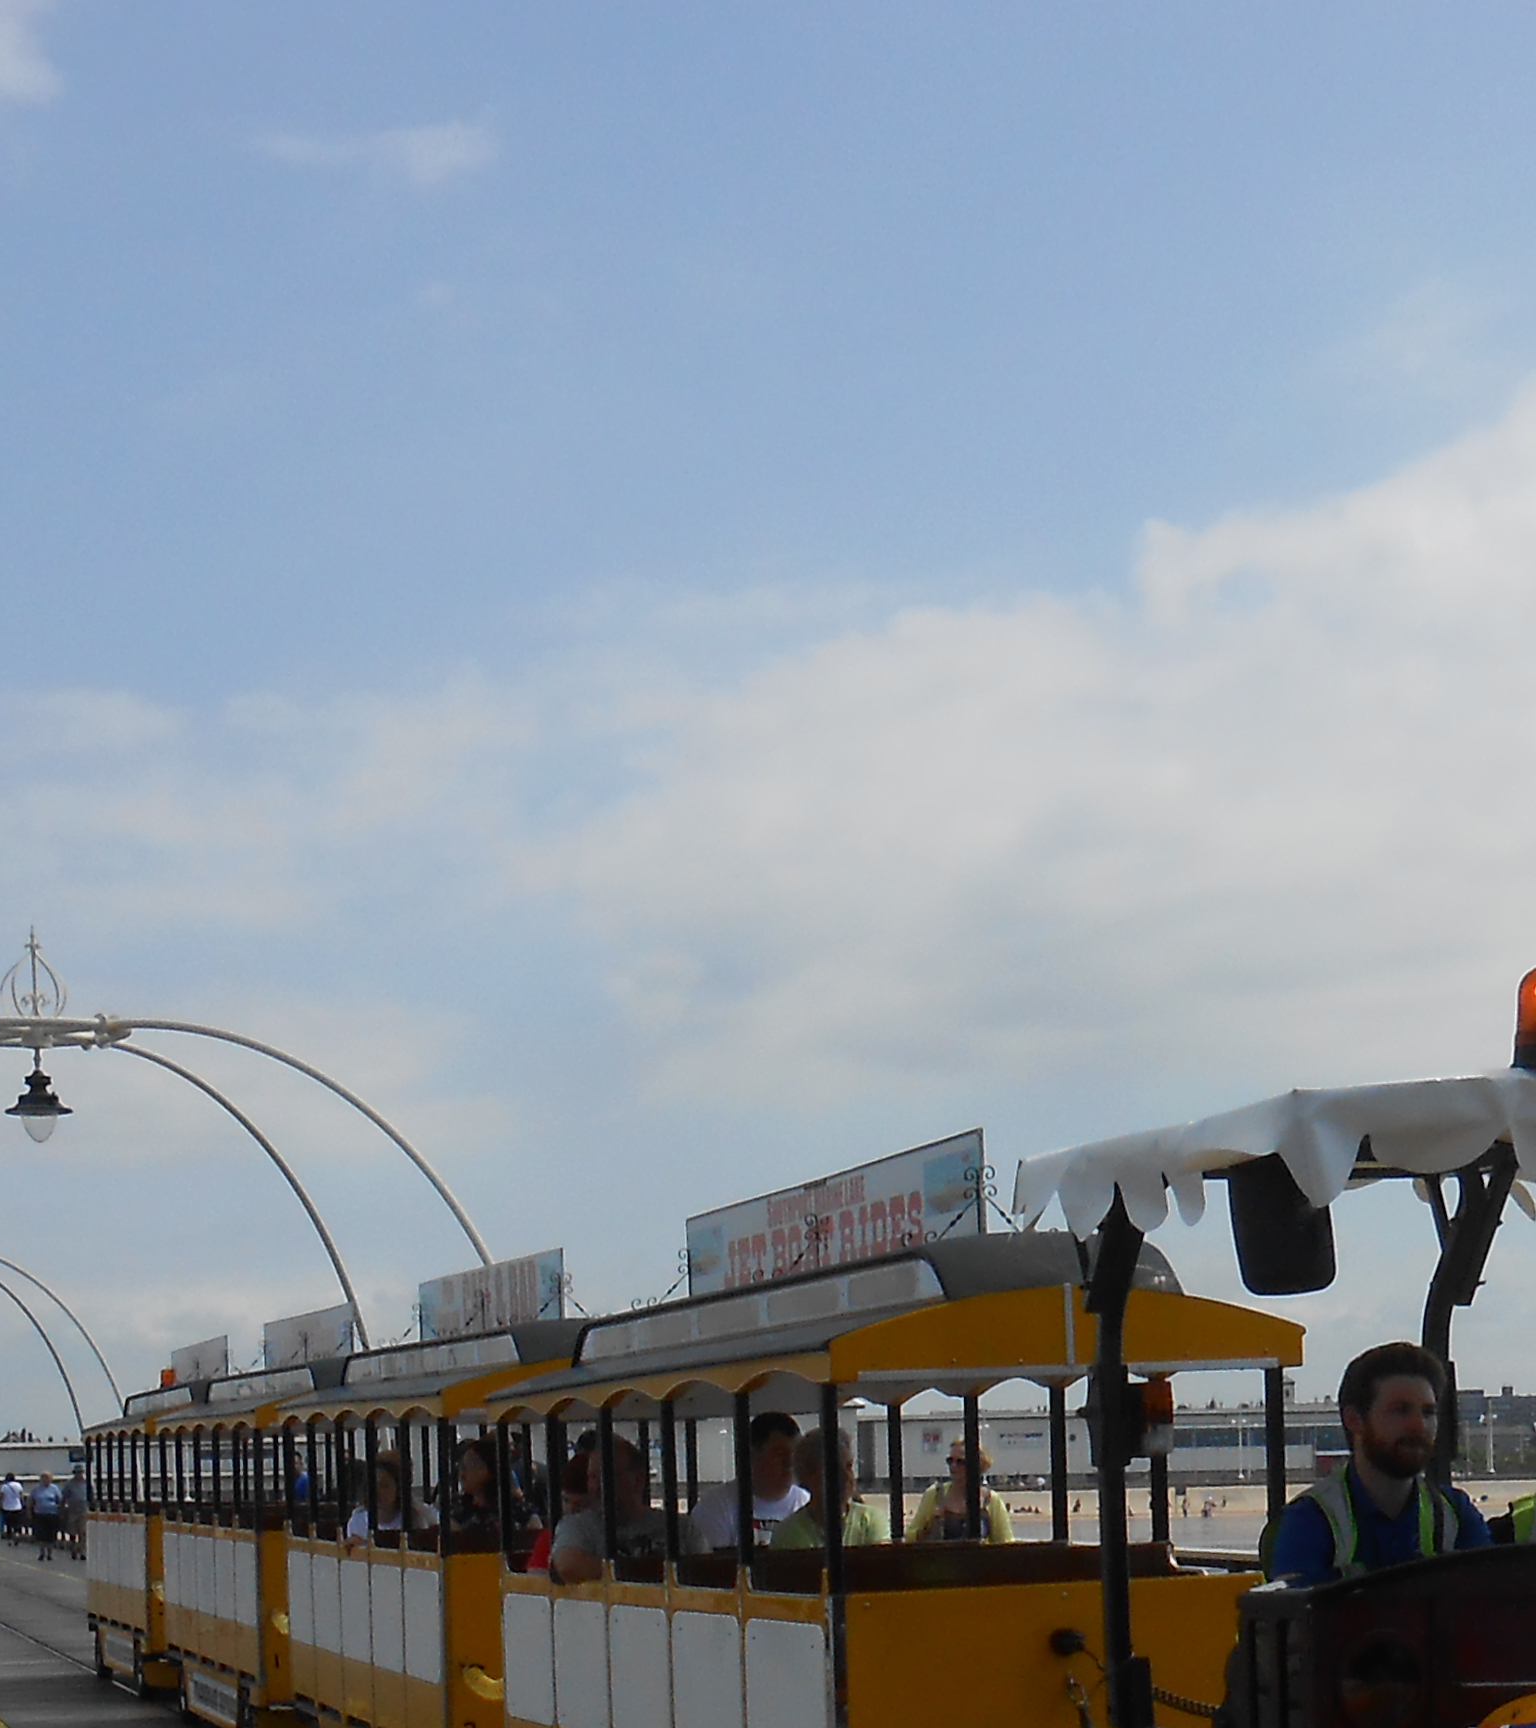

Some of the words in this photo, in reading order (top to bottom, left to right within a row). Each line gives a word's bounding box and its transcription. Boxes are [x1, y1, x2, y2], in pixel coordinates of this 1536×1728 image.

[724, 1232, 767, 1288] JET
[770, 1214, 834, 1276] BOAT
[838, 1190, 924, 1260] RIDES
